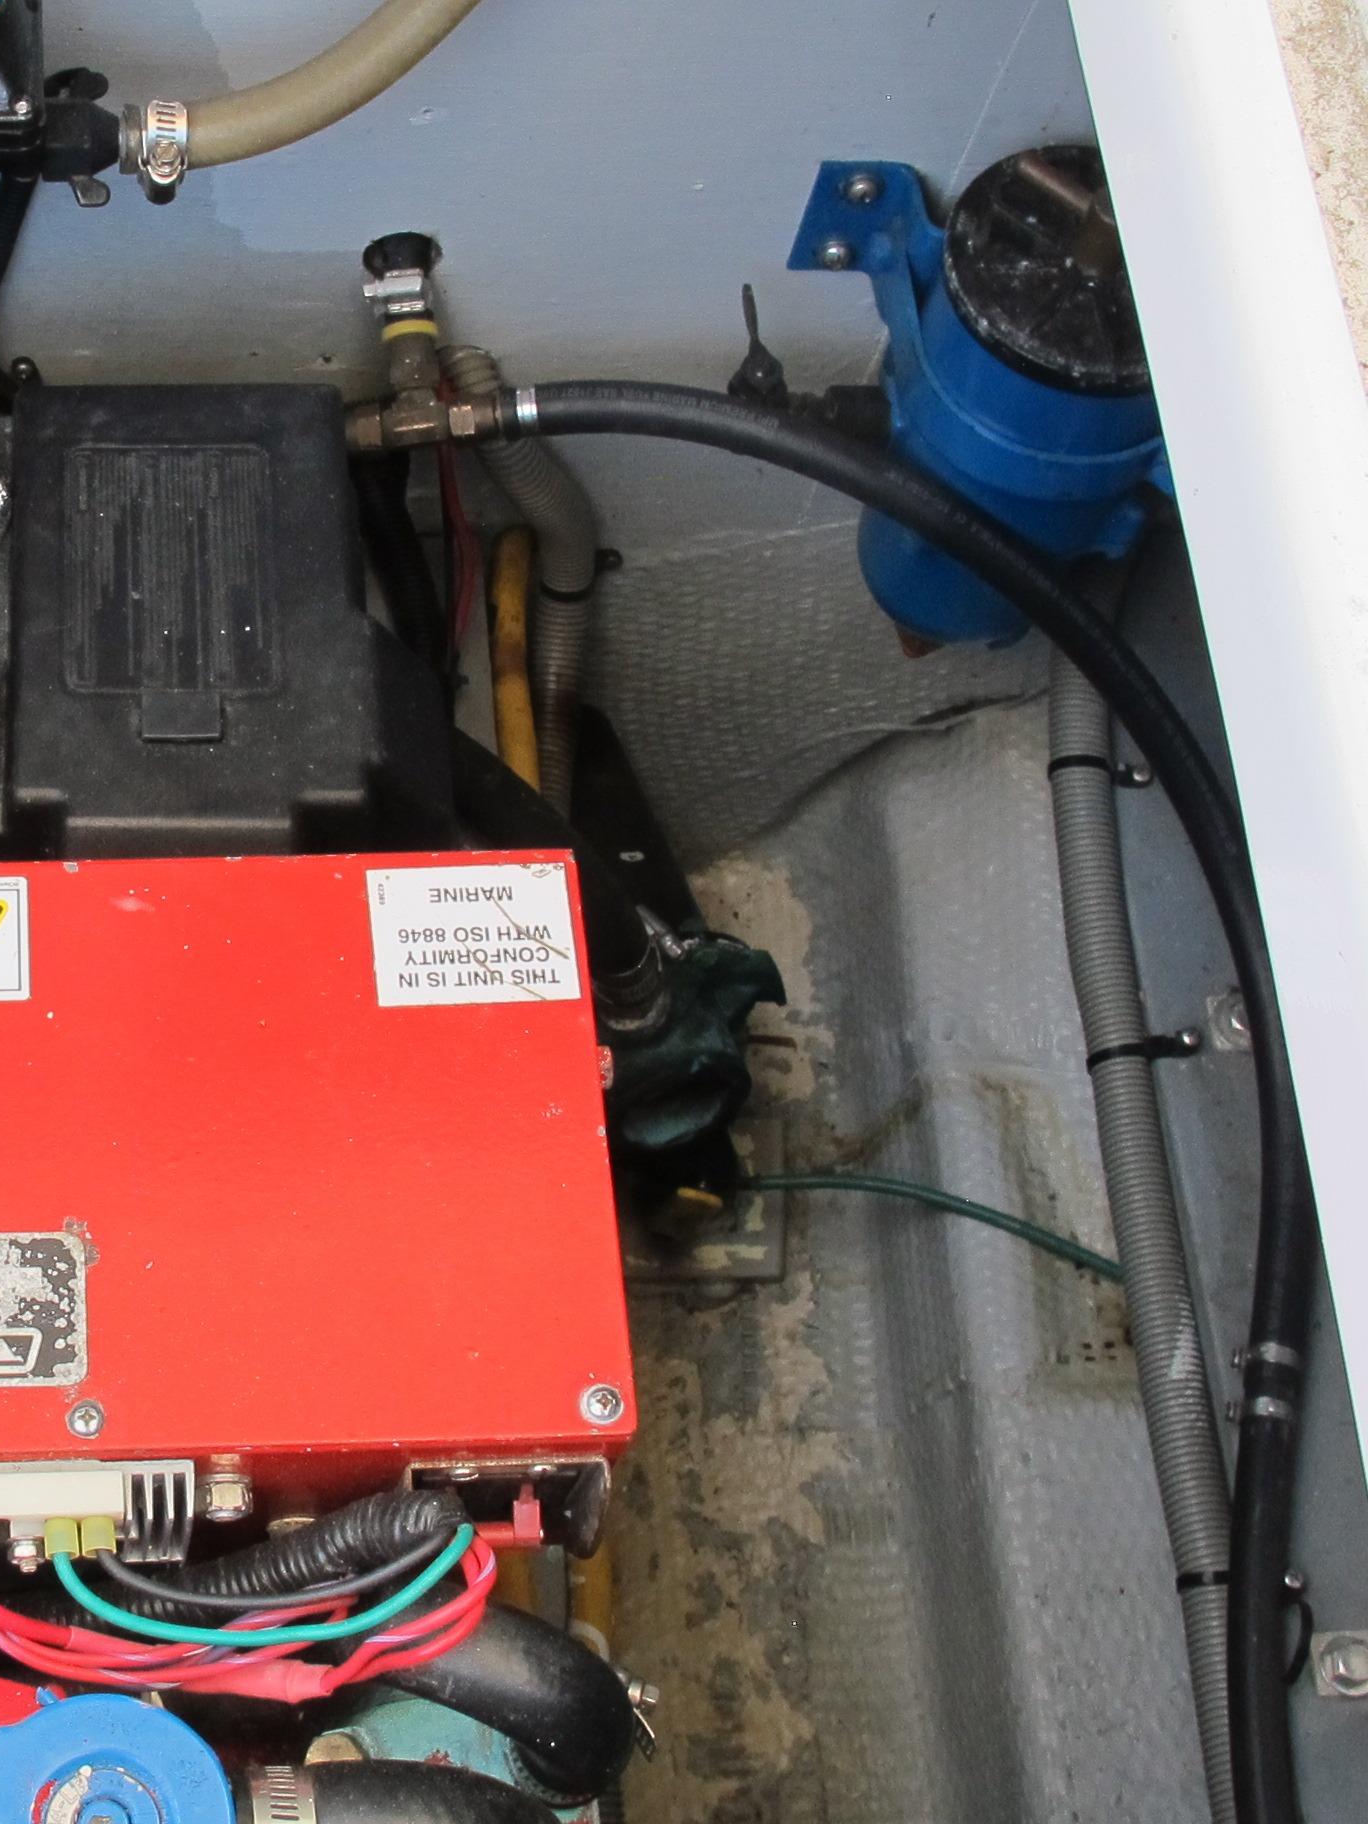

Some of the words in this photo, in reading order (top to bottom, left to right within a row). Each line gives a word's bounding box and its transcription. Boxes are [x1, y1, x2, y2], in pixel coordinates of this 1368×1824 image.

[429, 886, 513, 903] MARINE
[398, 927, 446, 944] 8846
[453, 926, 490, 943] ISO
[496, 925, 551, 942] WITH
[404, 947, 550, 966] CONFORMITY
[398, 973, 419, 988] IN
[426, 972, 446, 988] IS
[454, 970, 504, 987] UNIT
[511, 968, 560, 985] THIS
